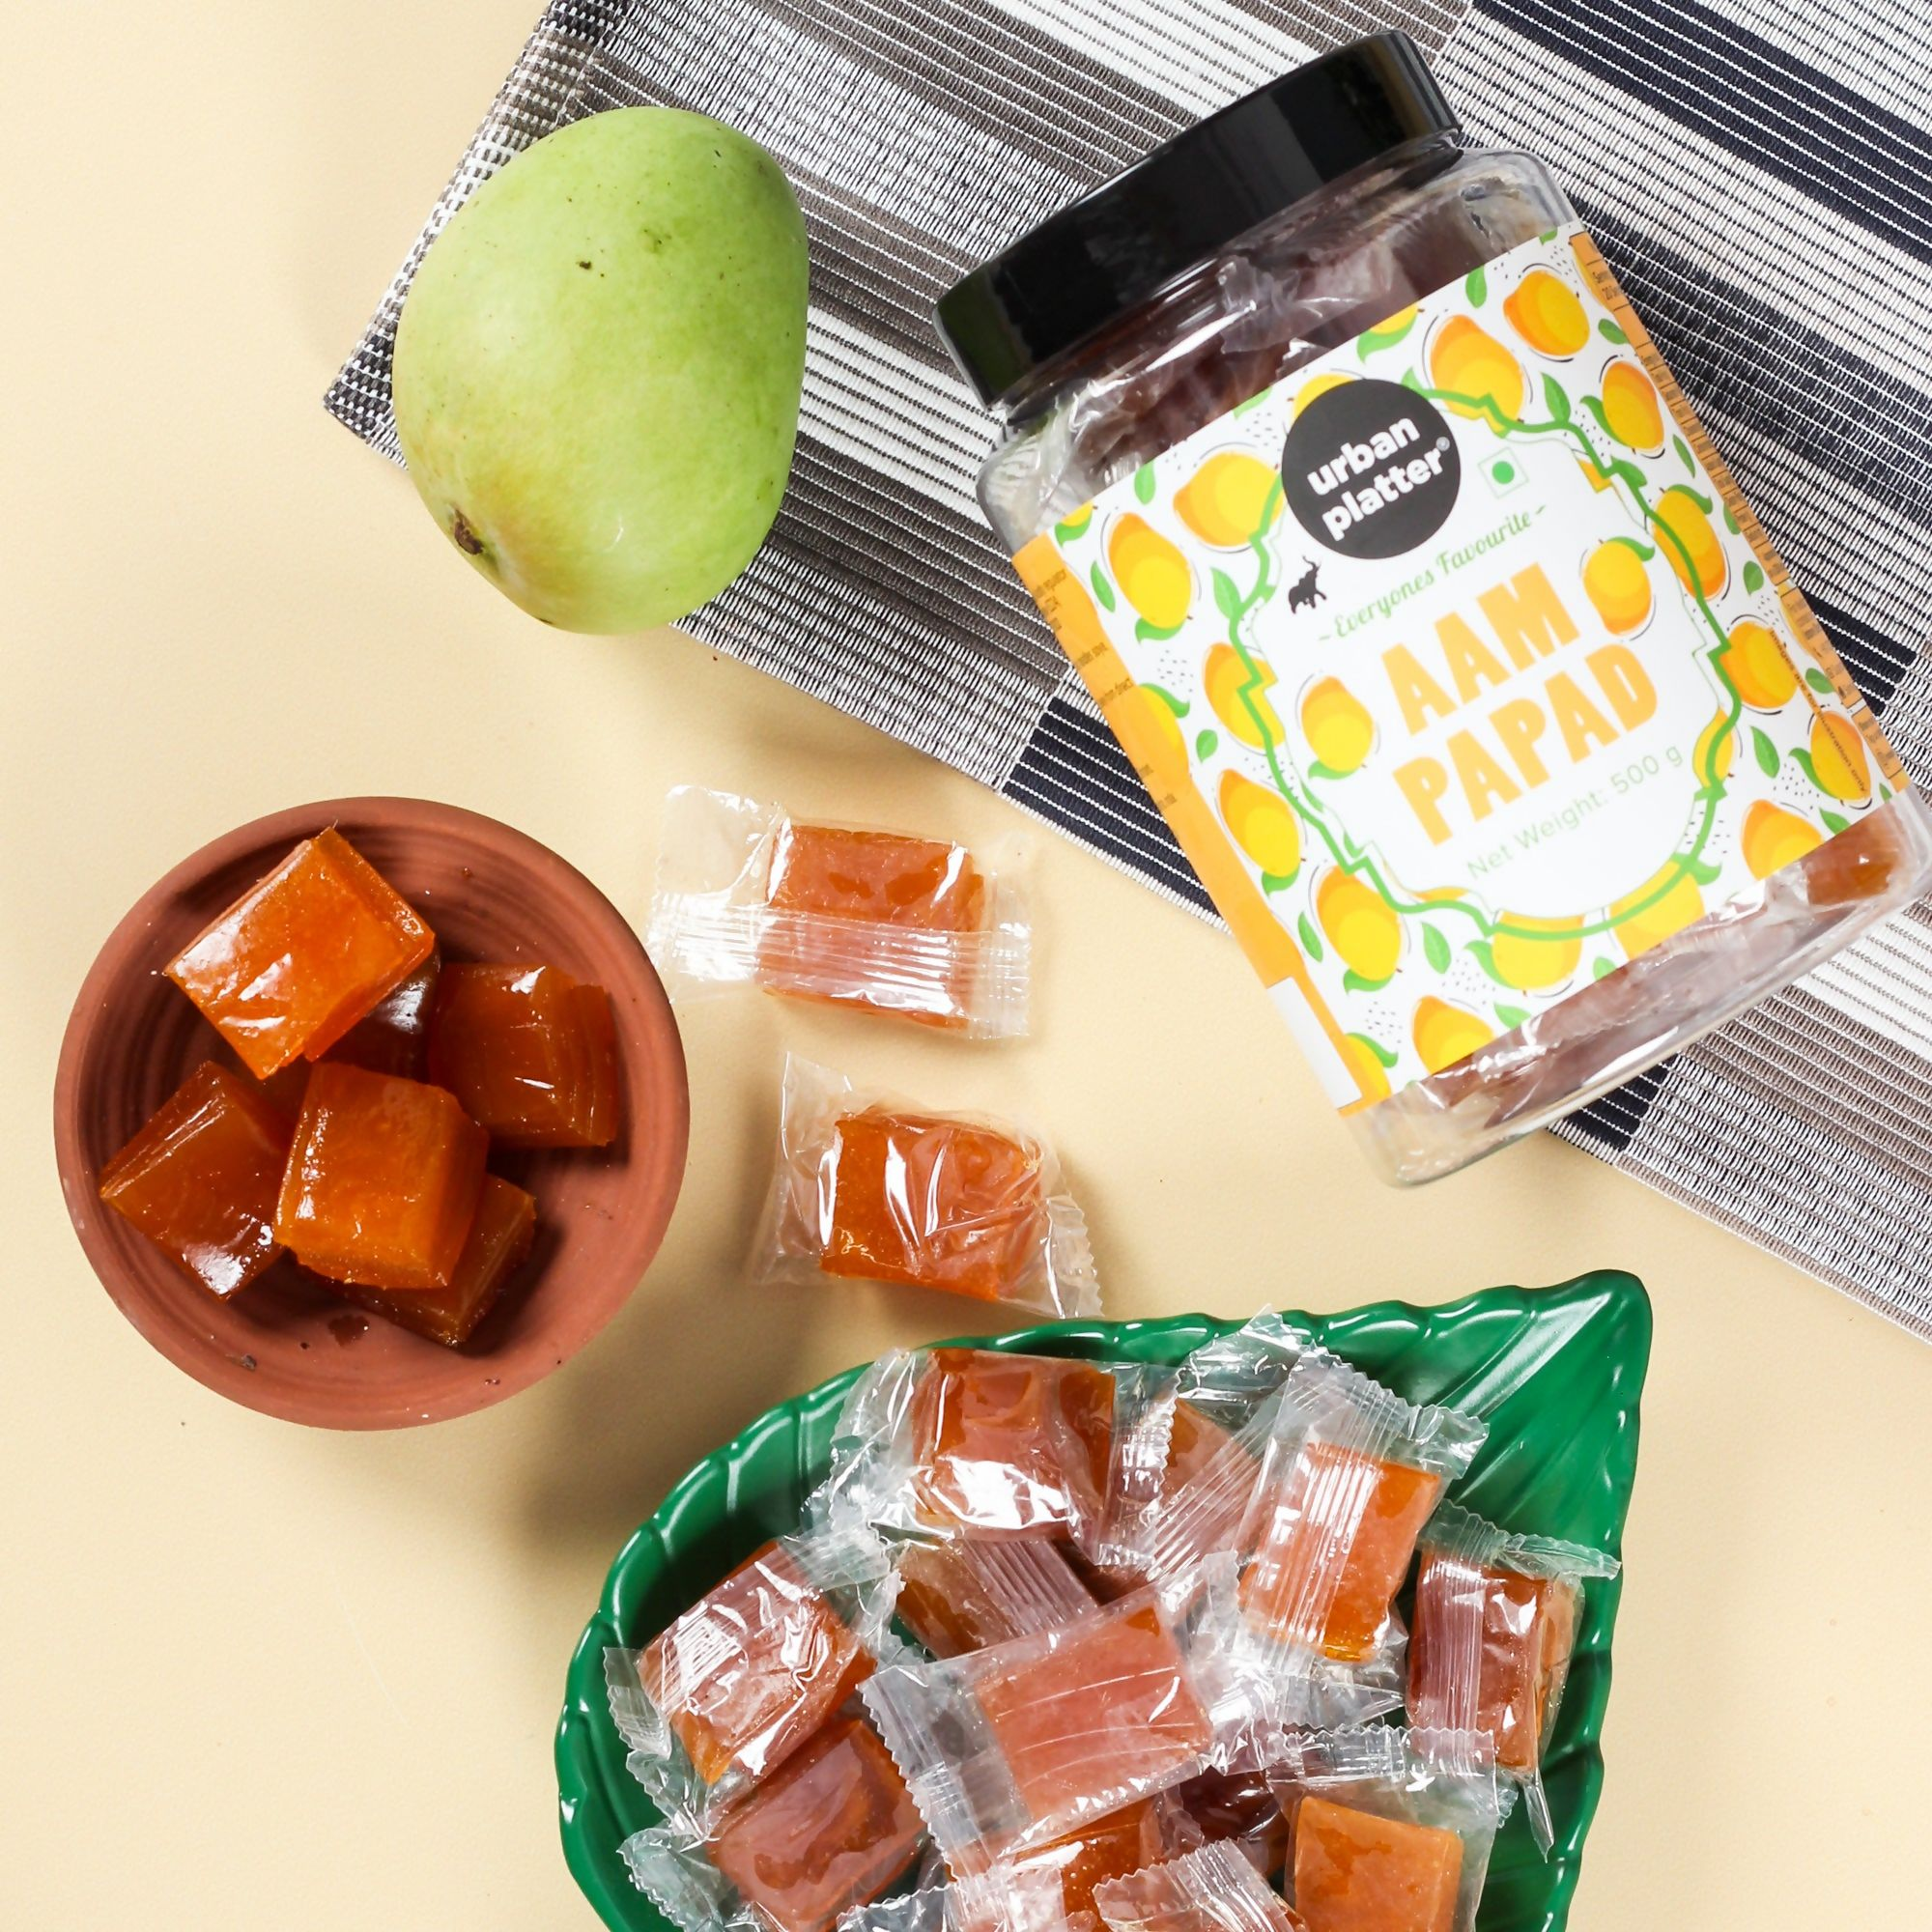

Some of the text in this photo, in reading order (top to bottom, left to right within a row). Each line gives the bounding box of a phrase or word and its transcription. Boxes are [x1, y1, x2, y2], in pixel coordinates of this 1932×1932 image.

[1307, 417, 1421, 496] urban
[1334, 511, 1532, 638] Everyones Favourite
[1380, 561, 1580, 737] AAM
[1769, 628, 1795, 671] Images
[1794, 673, 1806, 691] are
[1807, 692, 1818, 709] for
[1851, 768, 1865, 791] only
[1392, 643, 1658, 847] PAPAD
[1466, 746, 1684, 879] Net Weight: 500 g
